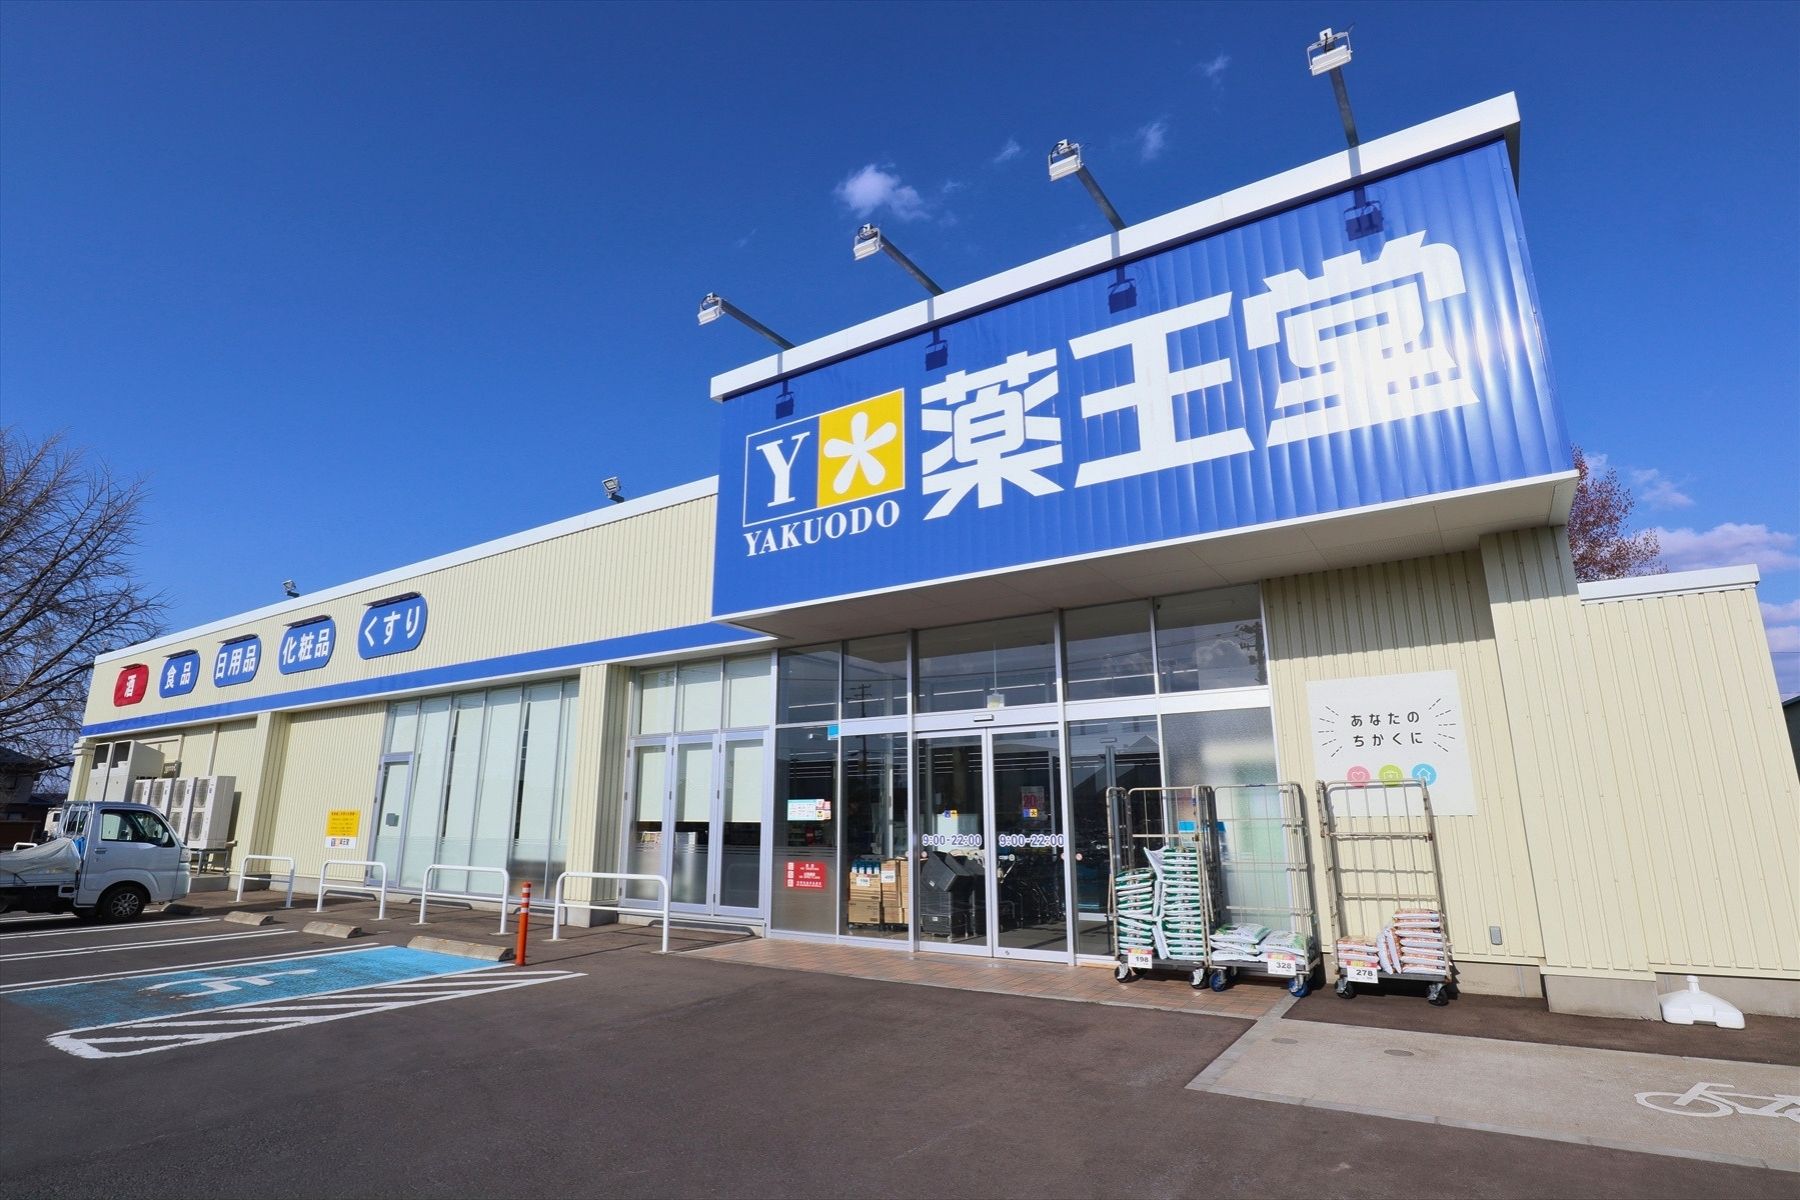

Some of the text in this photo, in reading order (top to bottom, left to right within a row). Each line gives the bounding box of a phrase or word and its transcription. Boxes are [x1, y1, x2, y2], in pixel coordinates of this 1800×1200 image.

[921, 229, 1480, 521] 薬王堂
[756, 431, 811, 507] Y
[743, 500, 900, 557] YAKUODO
[364, 605, 421, 648] くすり
[215, 644, 257, 680] 日用品
[282, 627, 330, 666] 化粧品
[164, 661, 192, 690] 食品
[1351, 711, 1420, 727] あなたの
[1353, 732, 1423, 748] ちかくに
[1275, 961, 1292, 969] 328
[1355, 969, 1373, 977] 278
